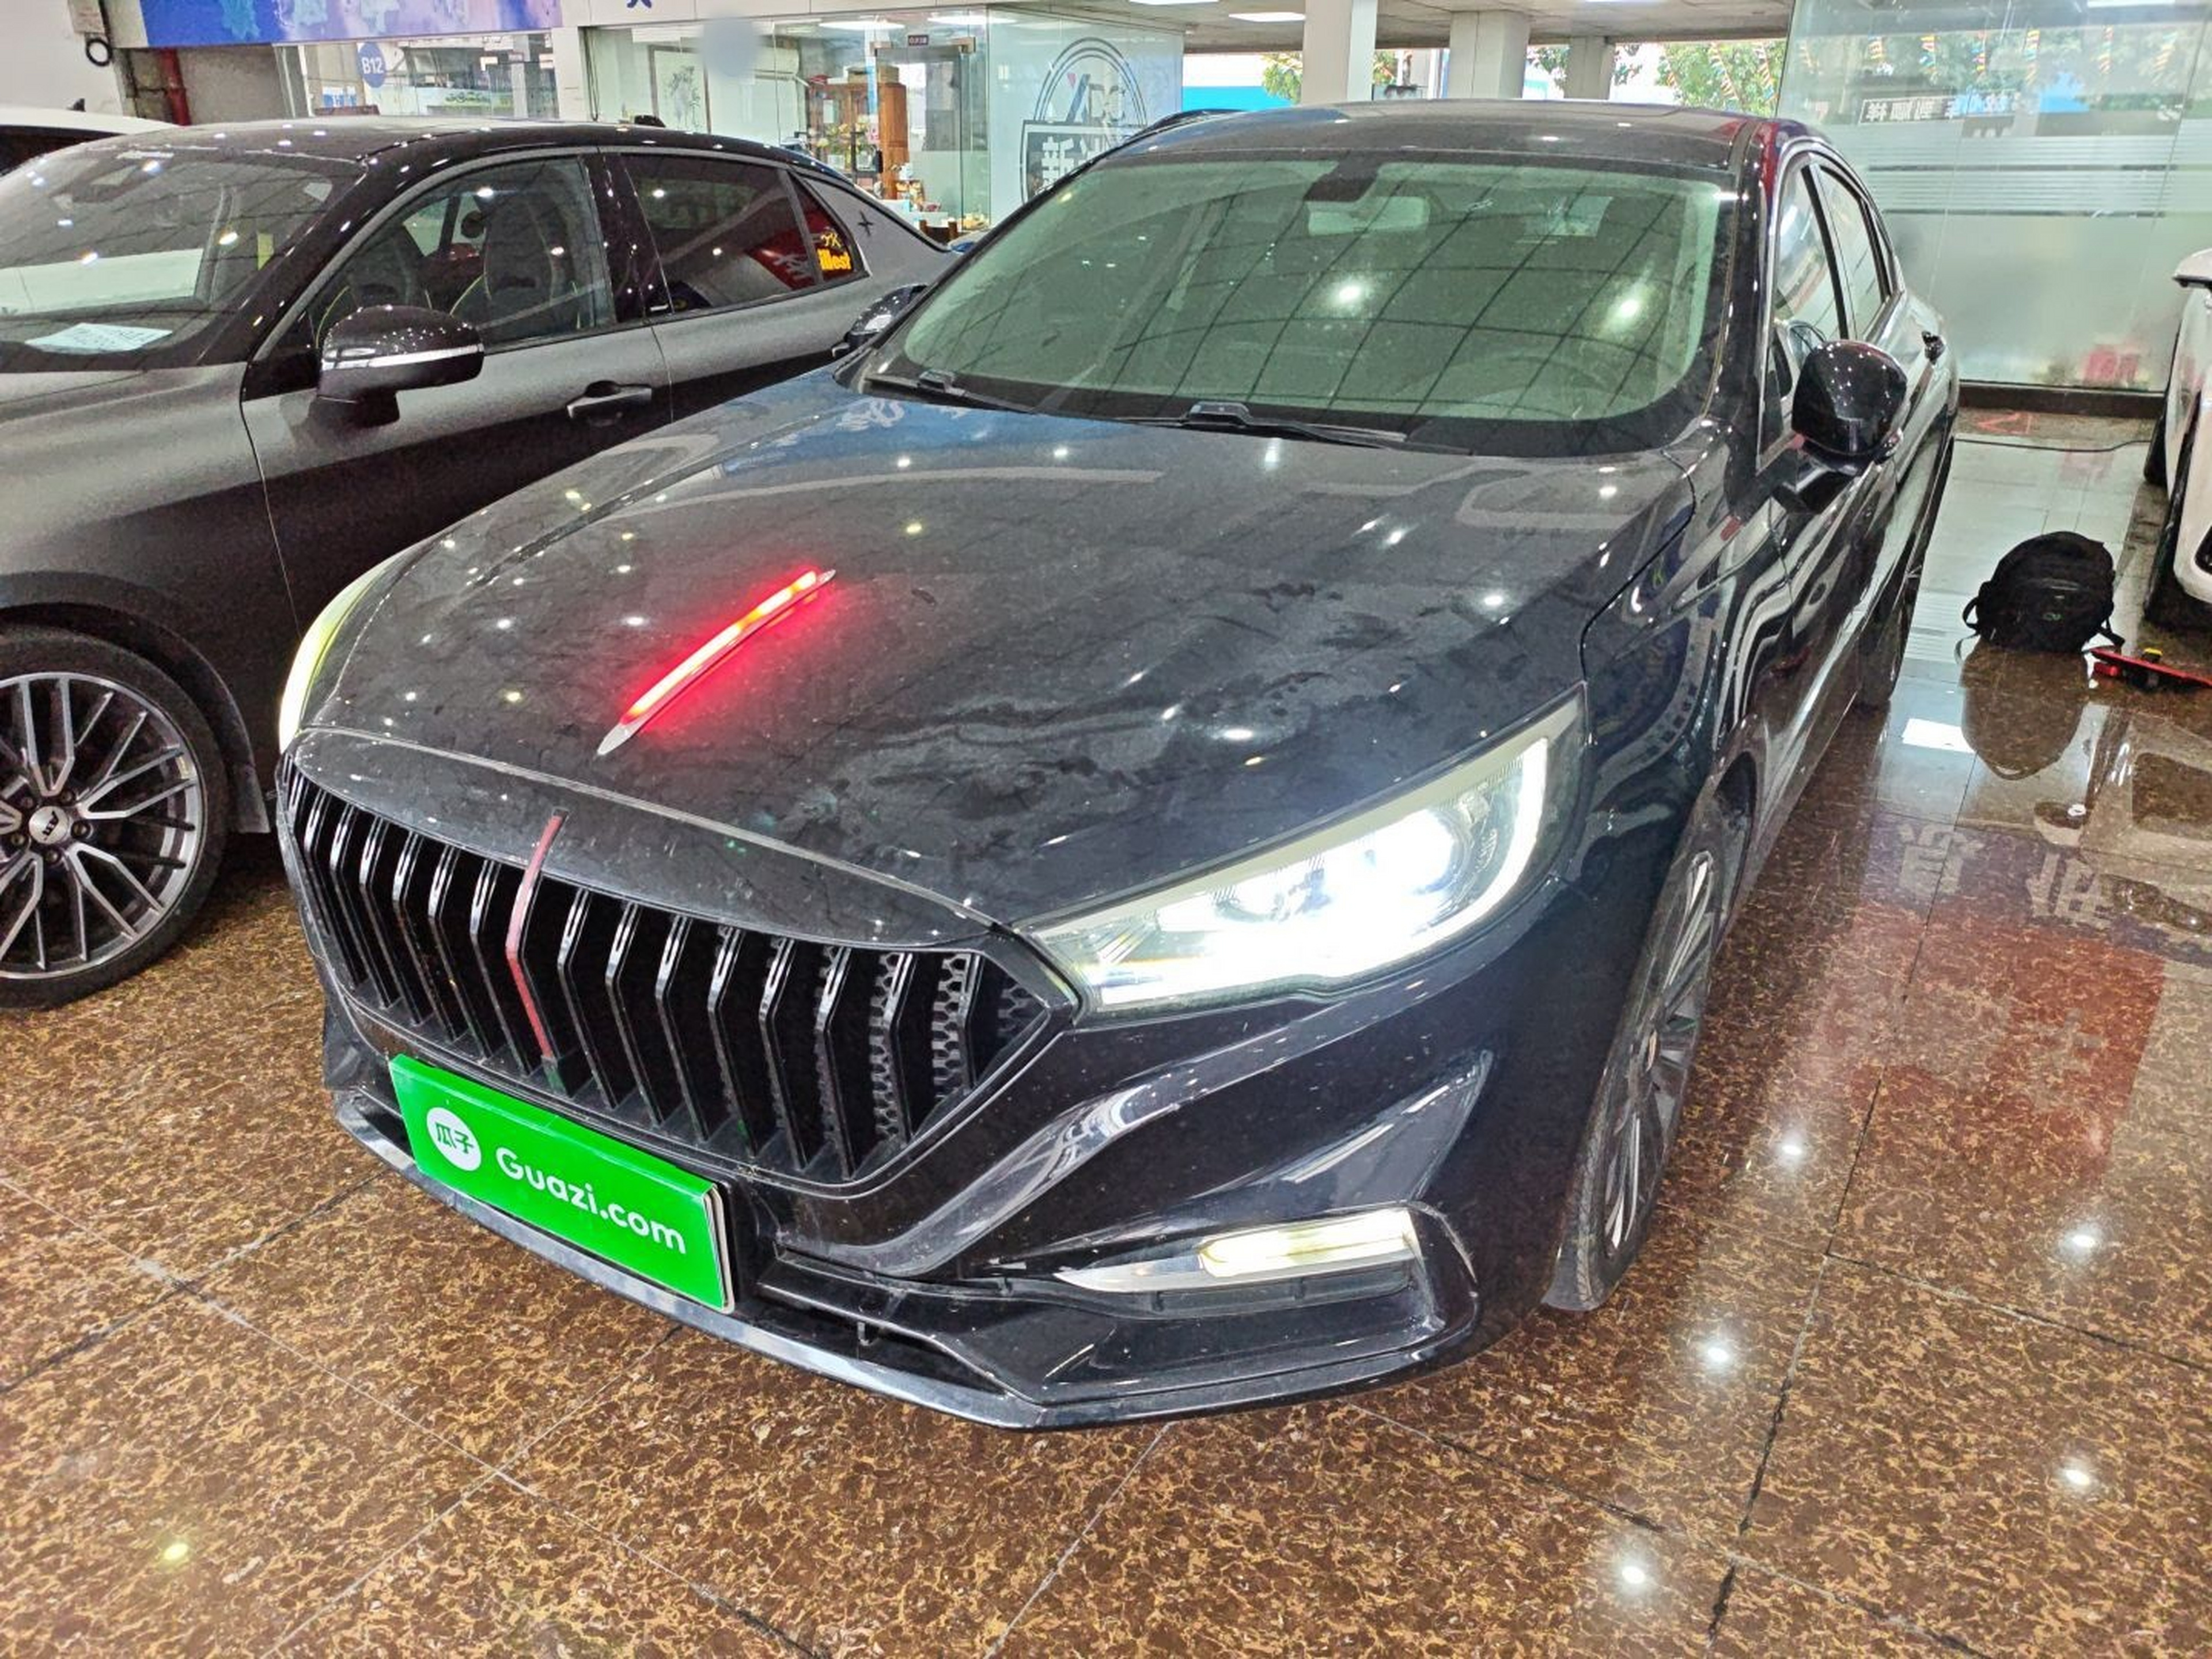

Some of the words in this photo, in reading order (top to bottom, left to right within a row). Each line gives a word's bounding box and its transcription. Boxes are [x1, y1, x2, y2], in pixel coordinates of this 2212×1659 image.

[362, 58, 384, 74] B12
[436, 1123, 474, 1154] 瓜子
[495, 1146, 687, 1255] Guazi.com
